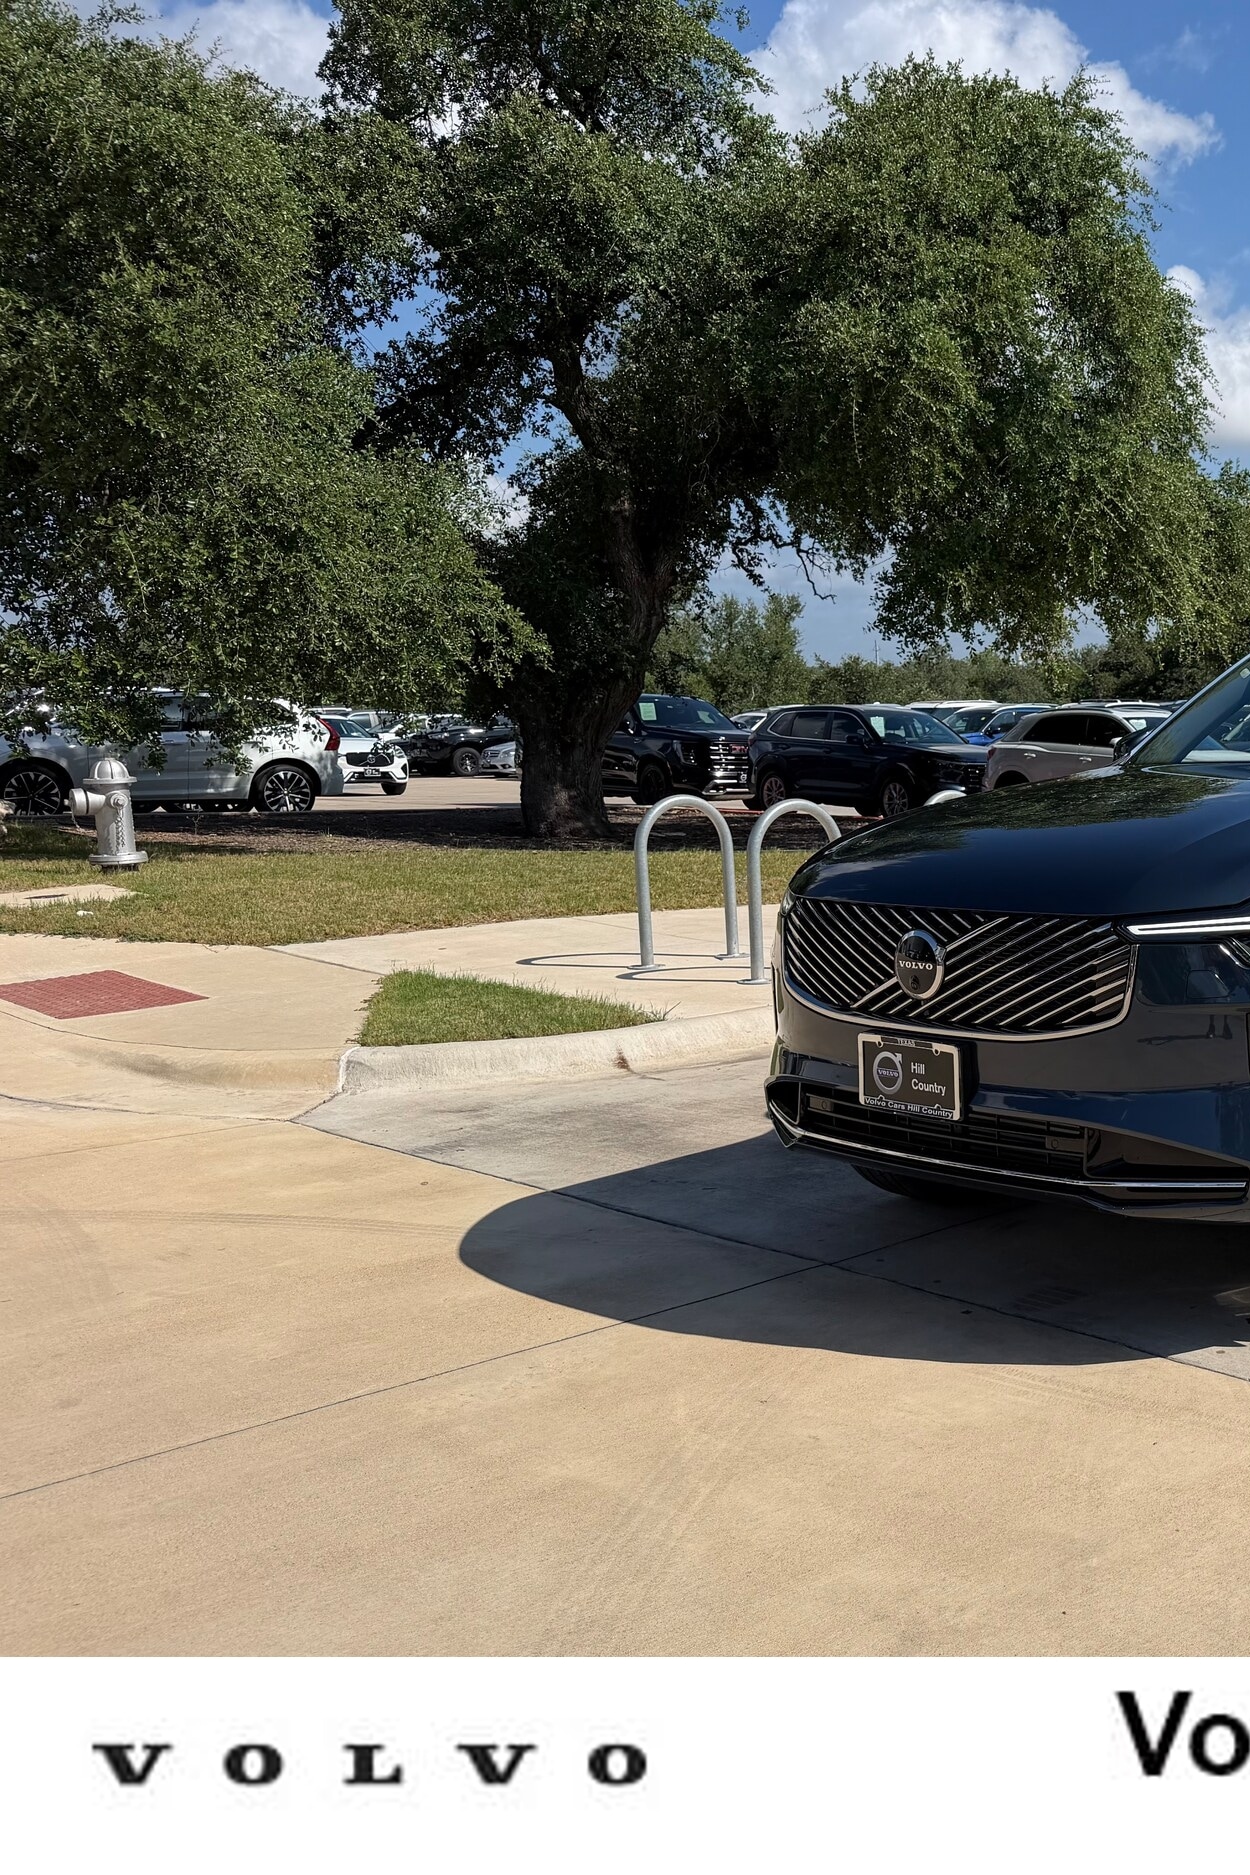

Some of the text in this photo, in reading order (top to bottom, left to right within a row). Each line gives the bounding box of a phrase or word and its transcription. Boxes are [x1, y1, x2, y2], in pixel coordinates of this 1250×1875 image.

[899, 960, 933, 970] VOLVO
[897, 1038, 916, 1047] TEXAS
[878, 1069, 899, 1077] VOLVO
[911, 1062, 925, 1075] Hill
[911, 1078, 946, 1096] Country
[865, 1097, 953, 1118] Volvo Cars Hill Country
